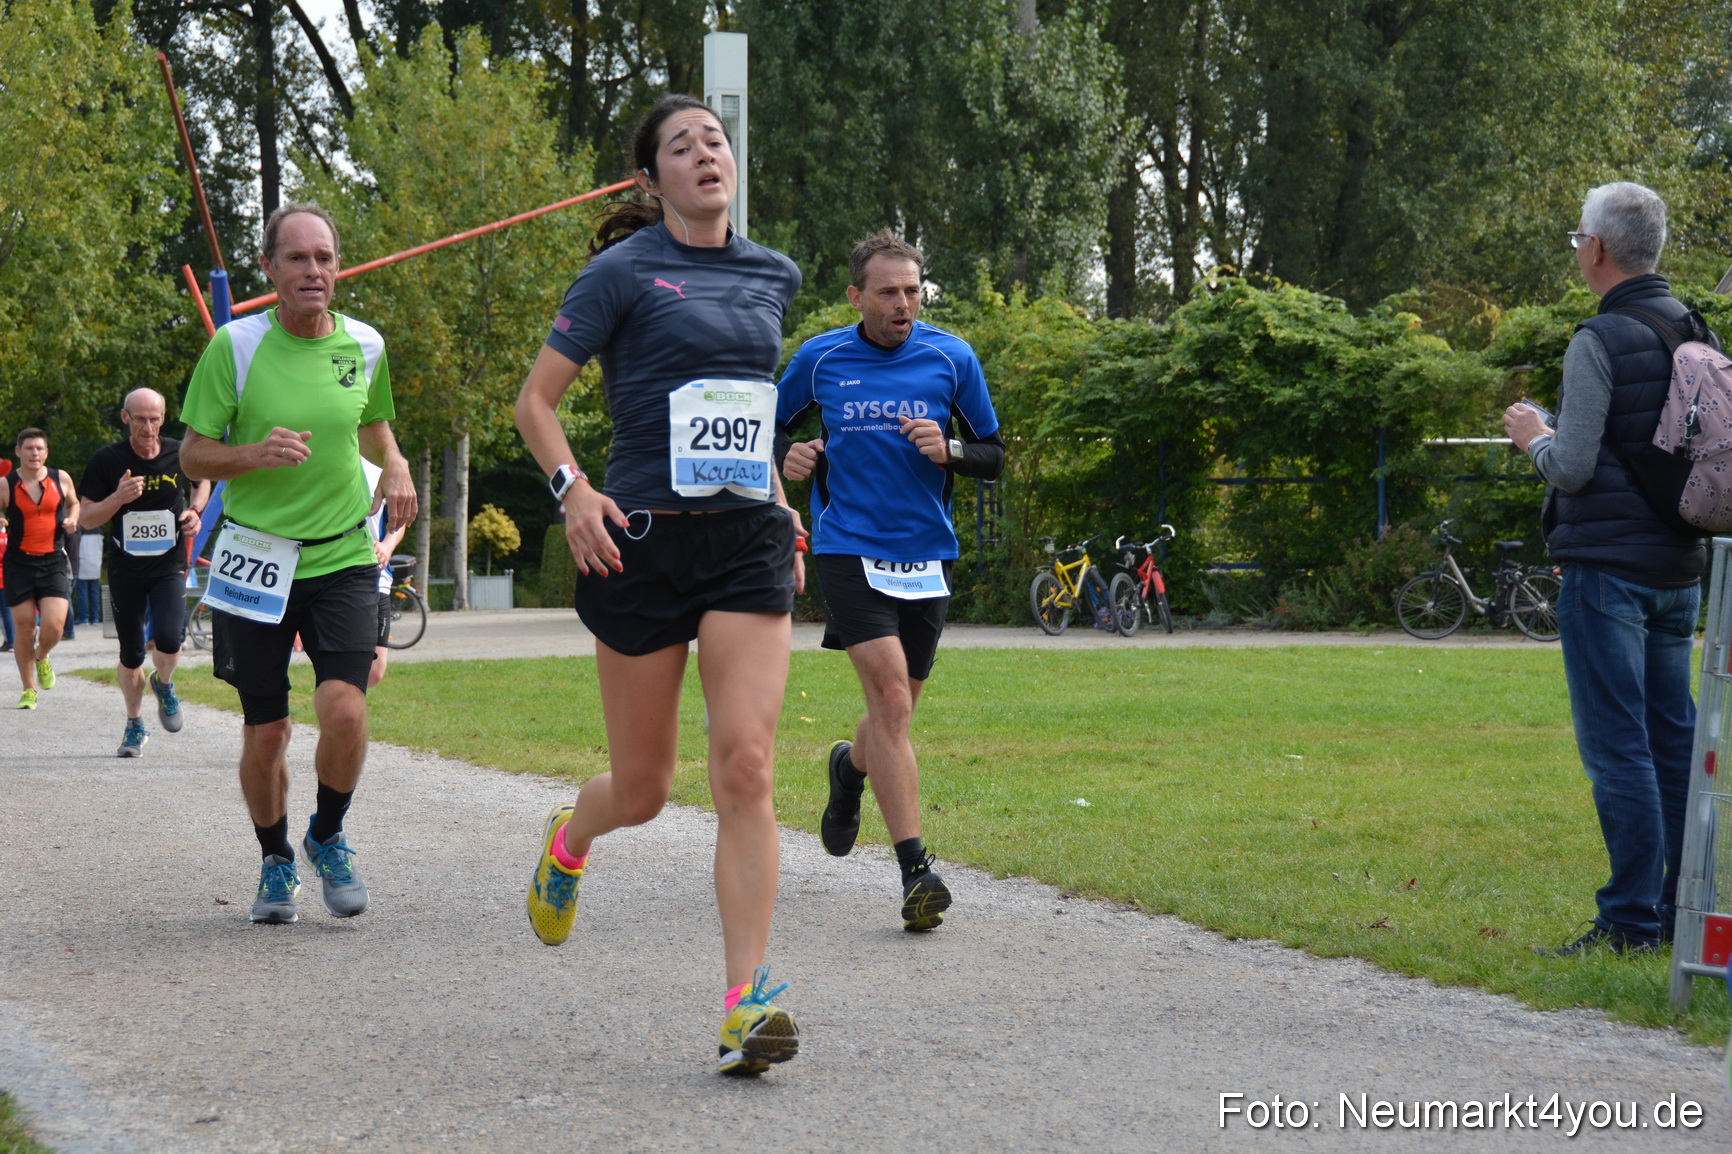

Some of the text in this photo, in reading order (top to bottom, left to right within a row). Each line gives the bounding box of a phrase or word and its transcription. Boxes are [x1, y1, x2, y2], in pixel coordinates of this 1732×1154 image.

[715, 391, 752, 402] BOCK
[843, 400, 928, 420] SYSCAD
[690, 416, 761, 453] 2997
[131, 524, 168, 539] 2936
[239, 535, 272, 550] BOCK
[218, 549, 280, 589] 2276
[885, 578, 923, 589] Wolfgang
[224, 586, 261, 605] Reinhard
